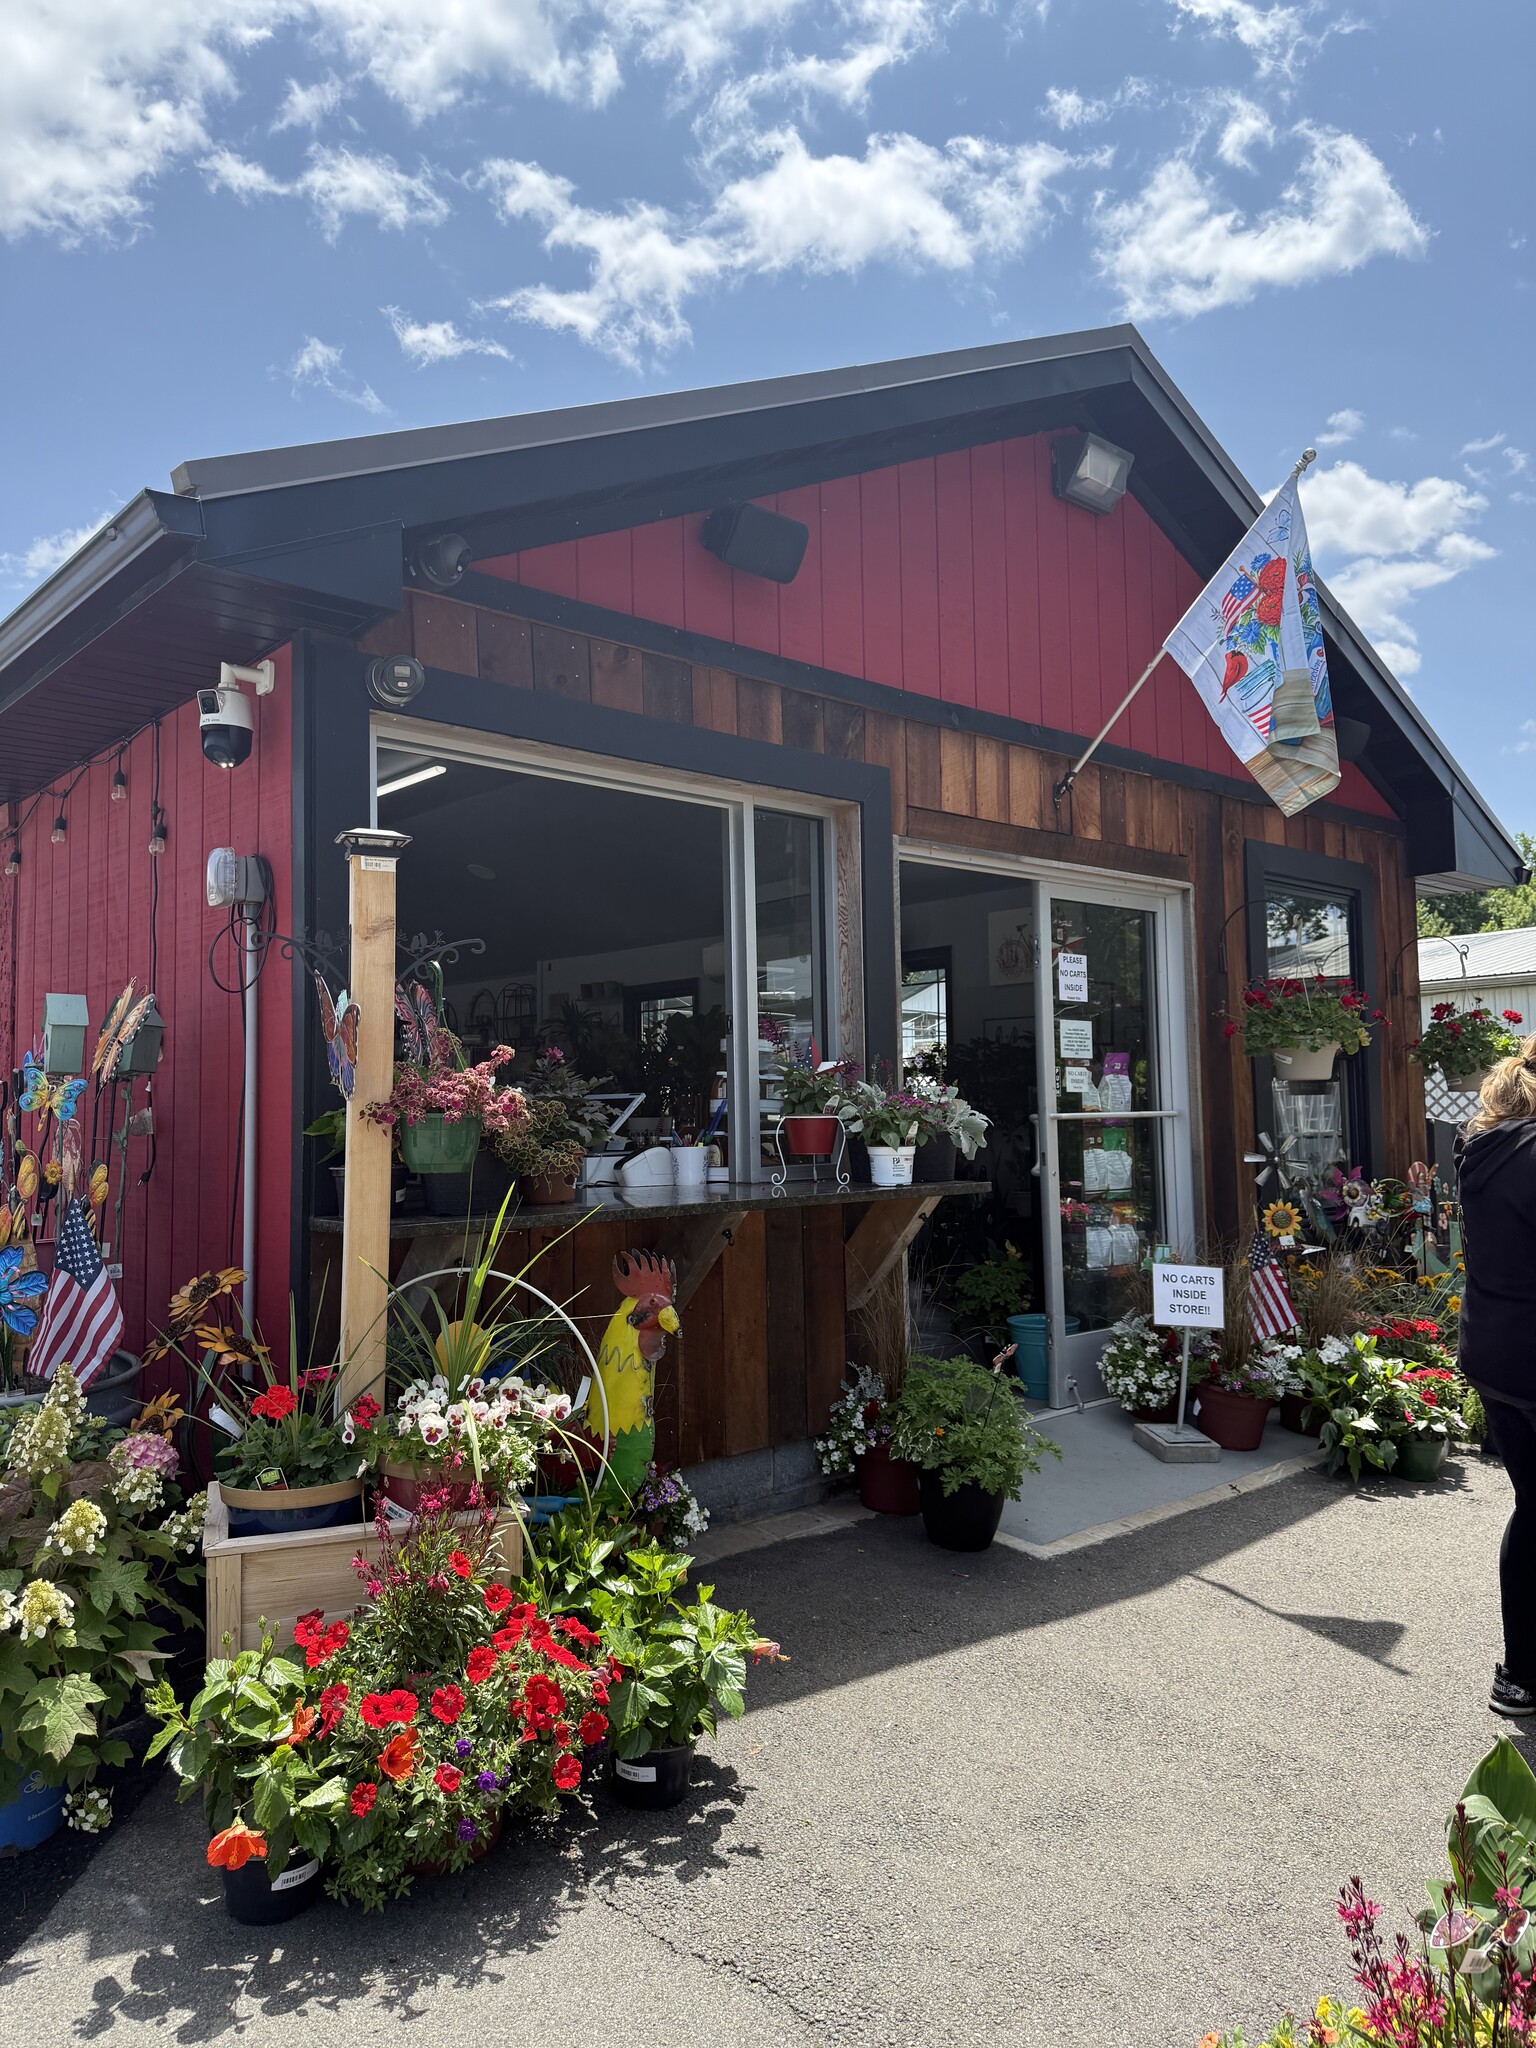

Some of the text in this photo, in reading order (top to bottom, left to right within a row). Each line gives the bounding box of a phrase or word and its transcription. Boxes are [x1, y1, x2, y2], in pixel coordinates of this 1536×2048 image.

[1063, 955, 1083, 965] PLEASE
[1060, 969, 1087, 979] NO CARTS
[1064, 983, 1083, 992] INSIDE
[1162, 1273, 1215, 1286] NO CARTS
[1173, 1289, 1207, 1300] INSIDE
[1169, 1303, 1211, 1315] STORE!!
